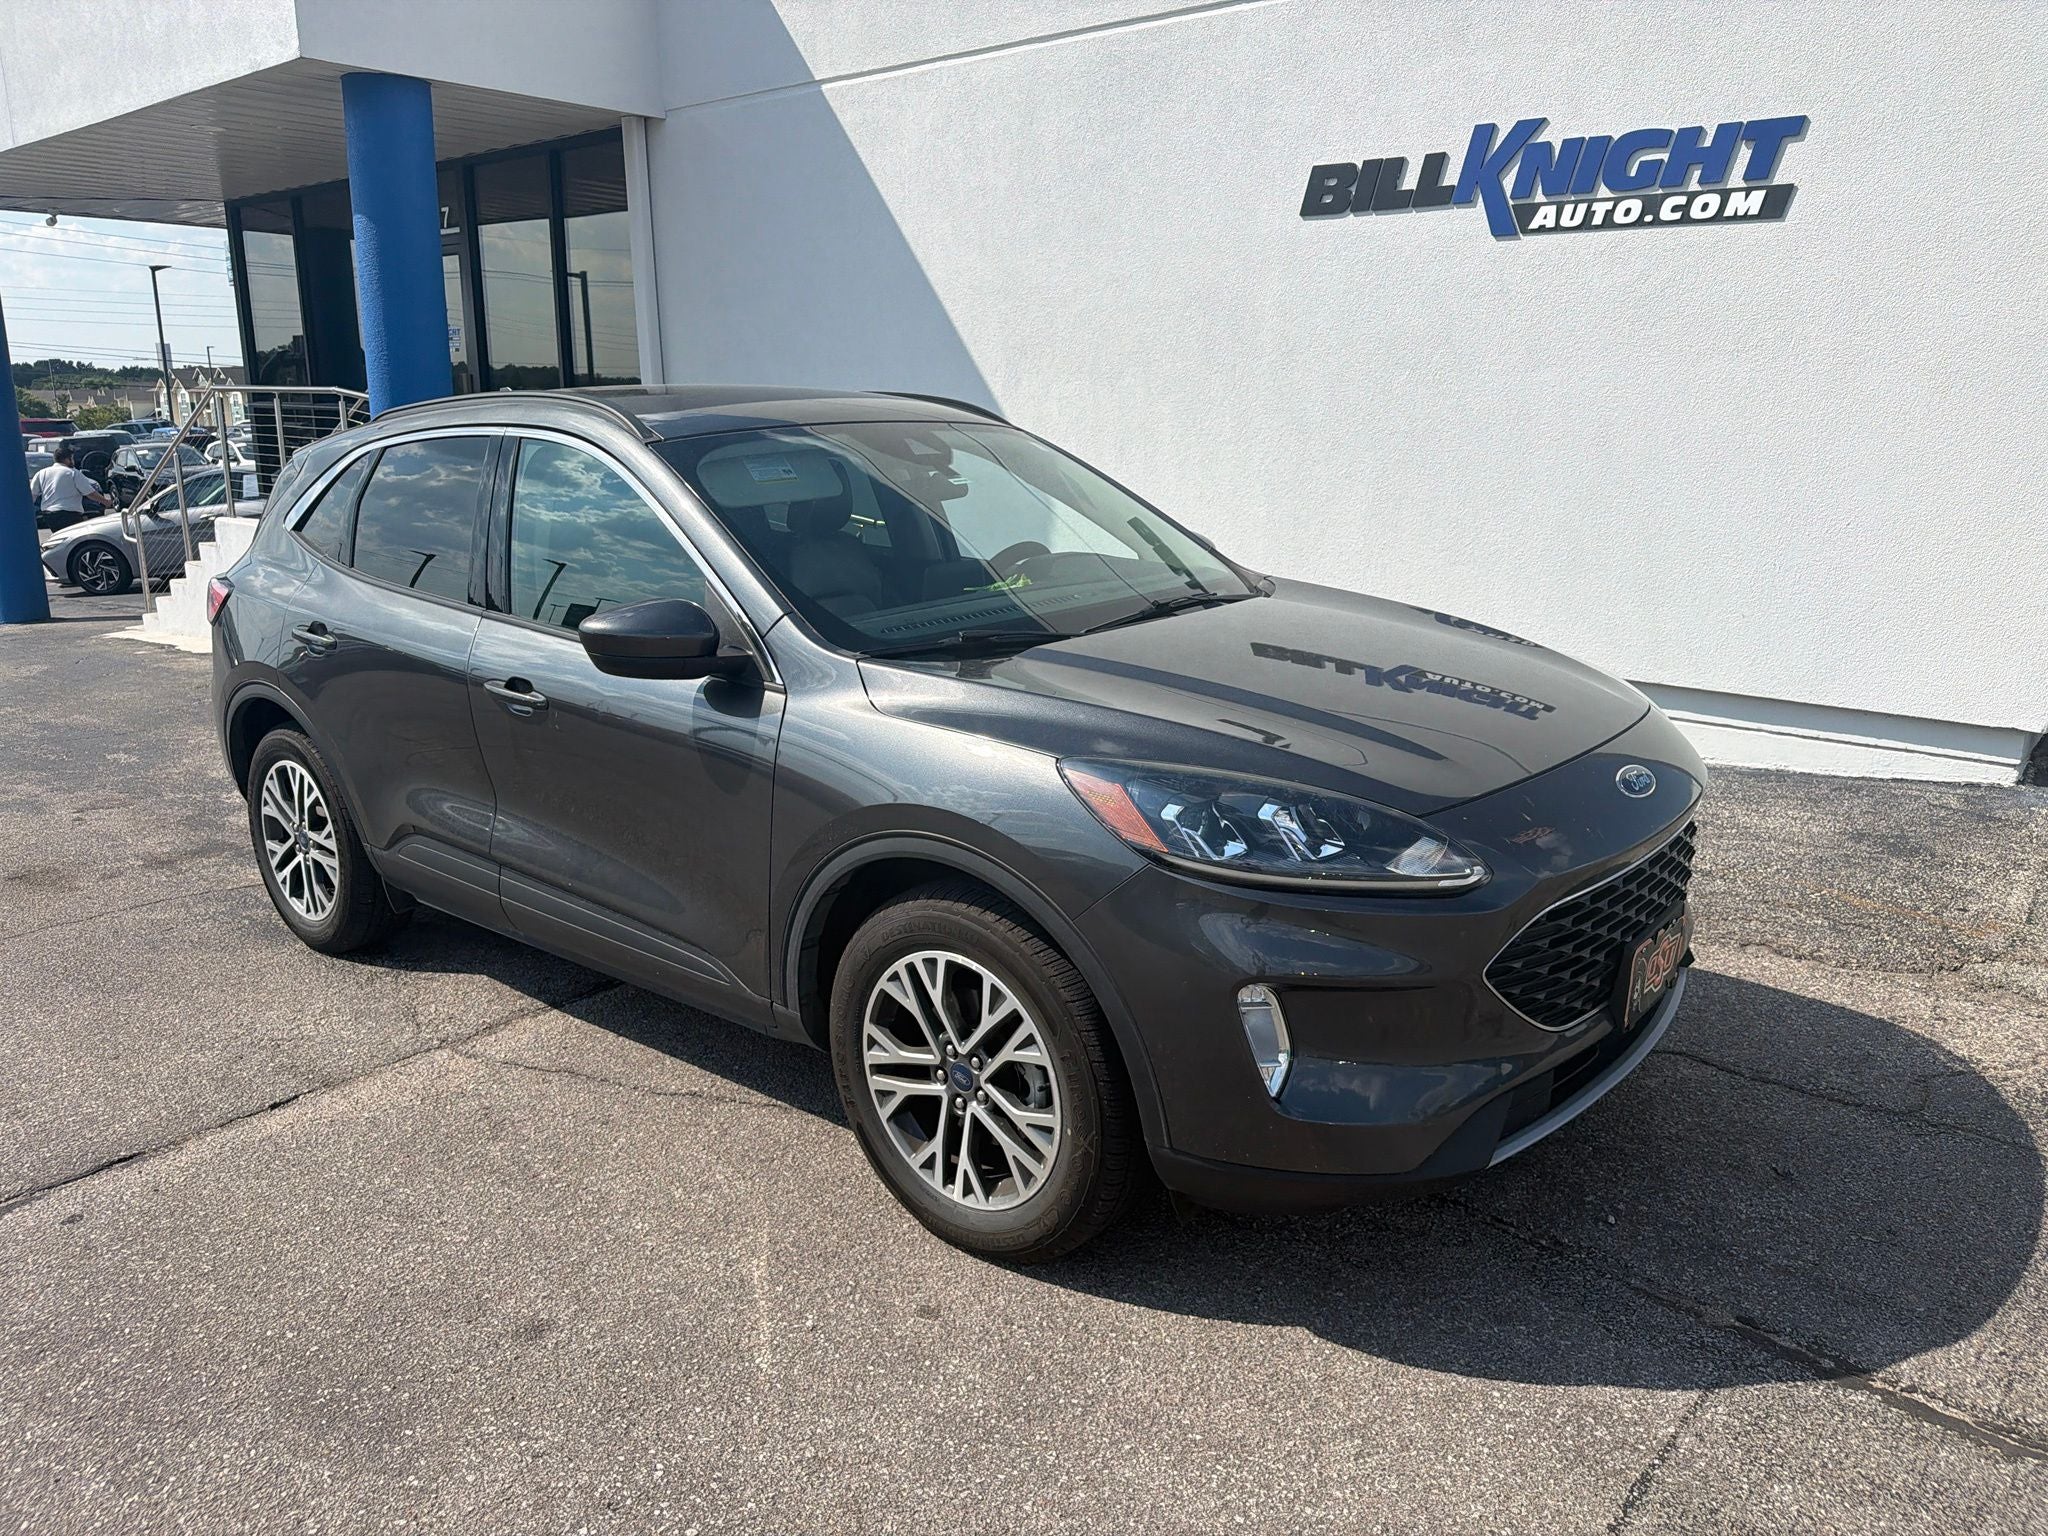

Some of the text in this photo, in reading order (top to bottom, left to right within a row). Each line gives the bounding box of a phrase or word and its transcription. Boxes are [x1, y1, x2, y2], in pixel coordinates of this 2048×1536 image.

[1300, 115, 1811, 241] BILL KNIGHT
[1527, 190, 1767, 231] AUTO.COM
[1625, 769, 1651, 791] Ford
